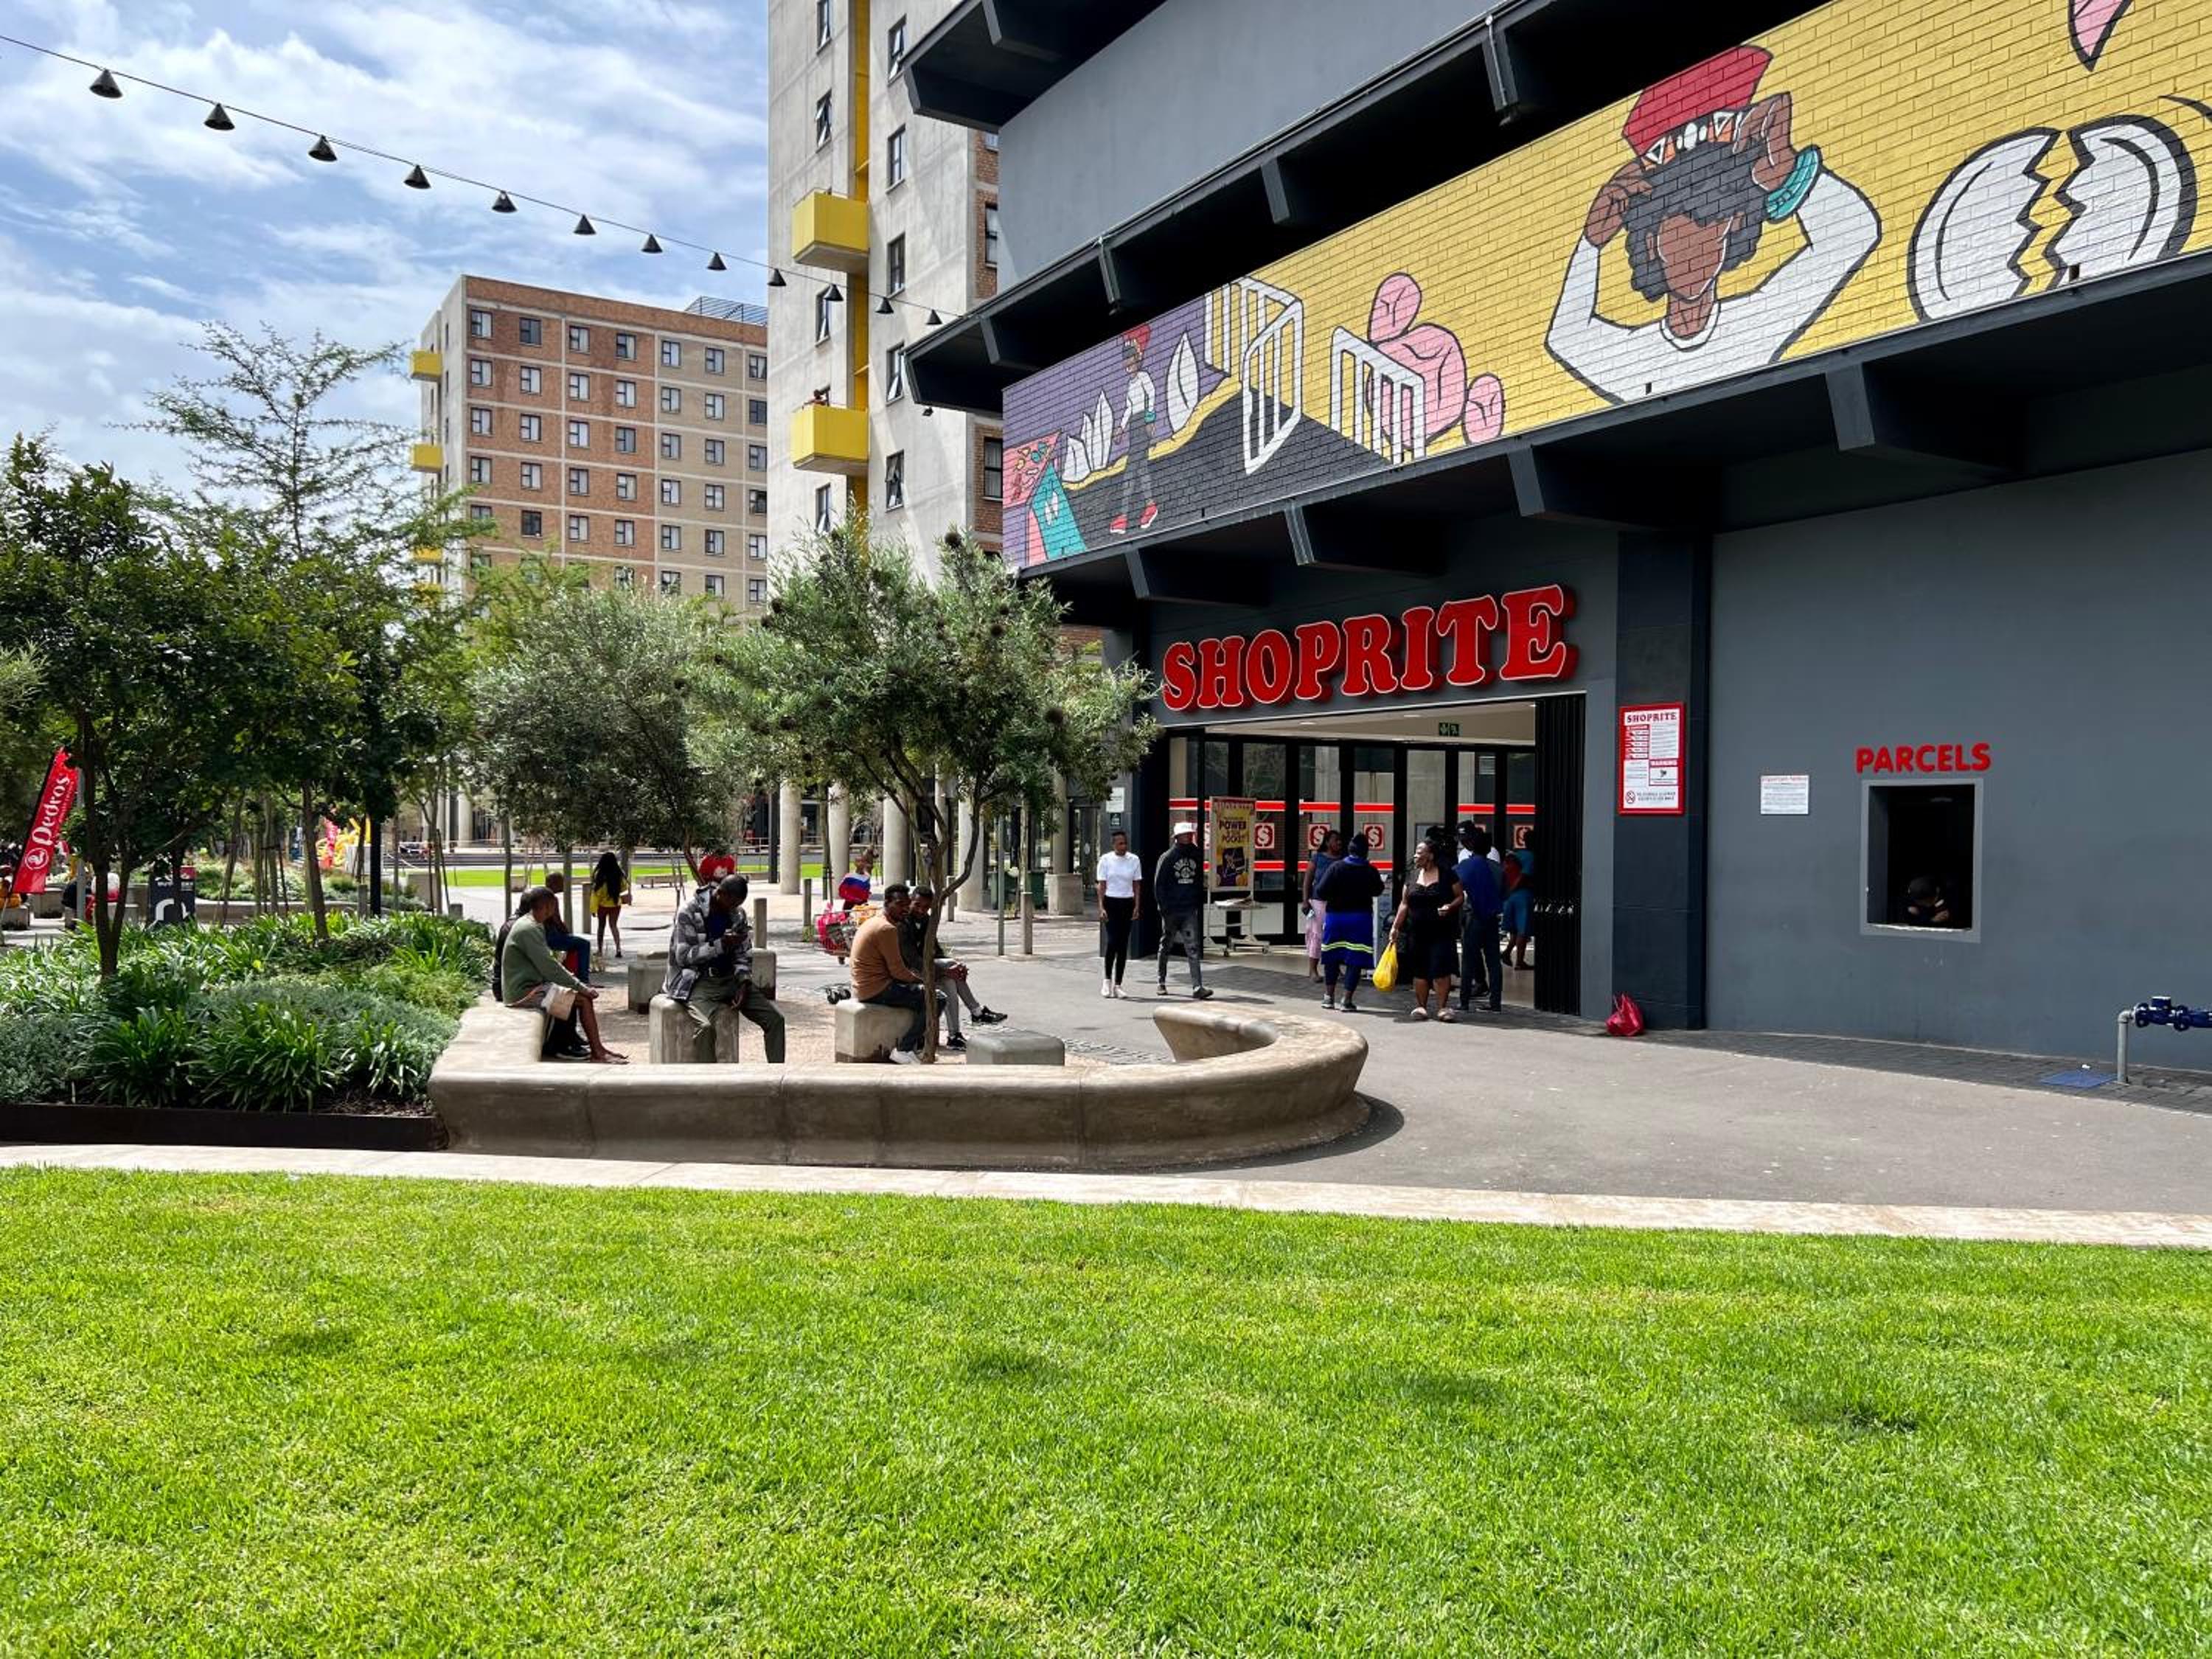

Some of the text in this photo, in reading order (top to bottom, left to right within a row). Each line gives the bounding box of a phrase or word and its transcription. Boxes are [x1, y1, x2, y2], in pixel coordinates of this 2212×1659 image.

[1162, 584, 1578, 712] SHOPRITE
[1627, 712, 1677, 723] SHOPRITE
[1856, 742, 1992, 773] PARCELS
[32, 776, 70, 846] Pedros
